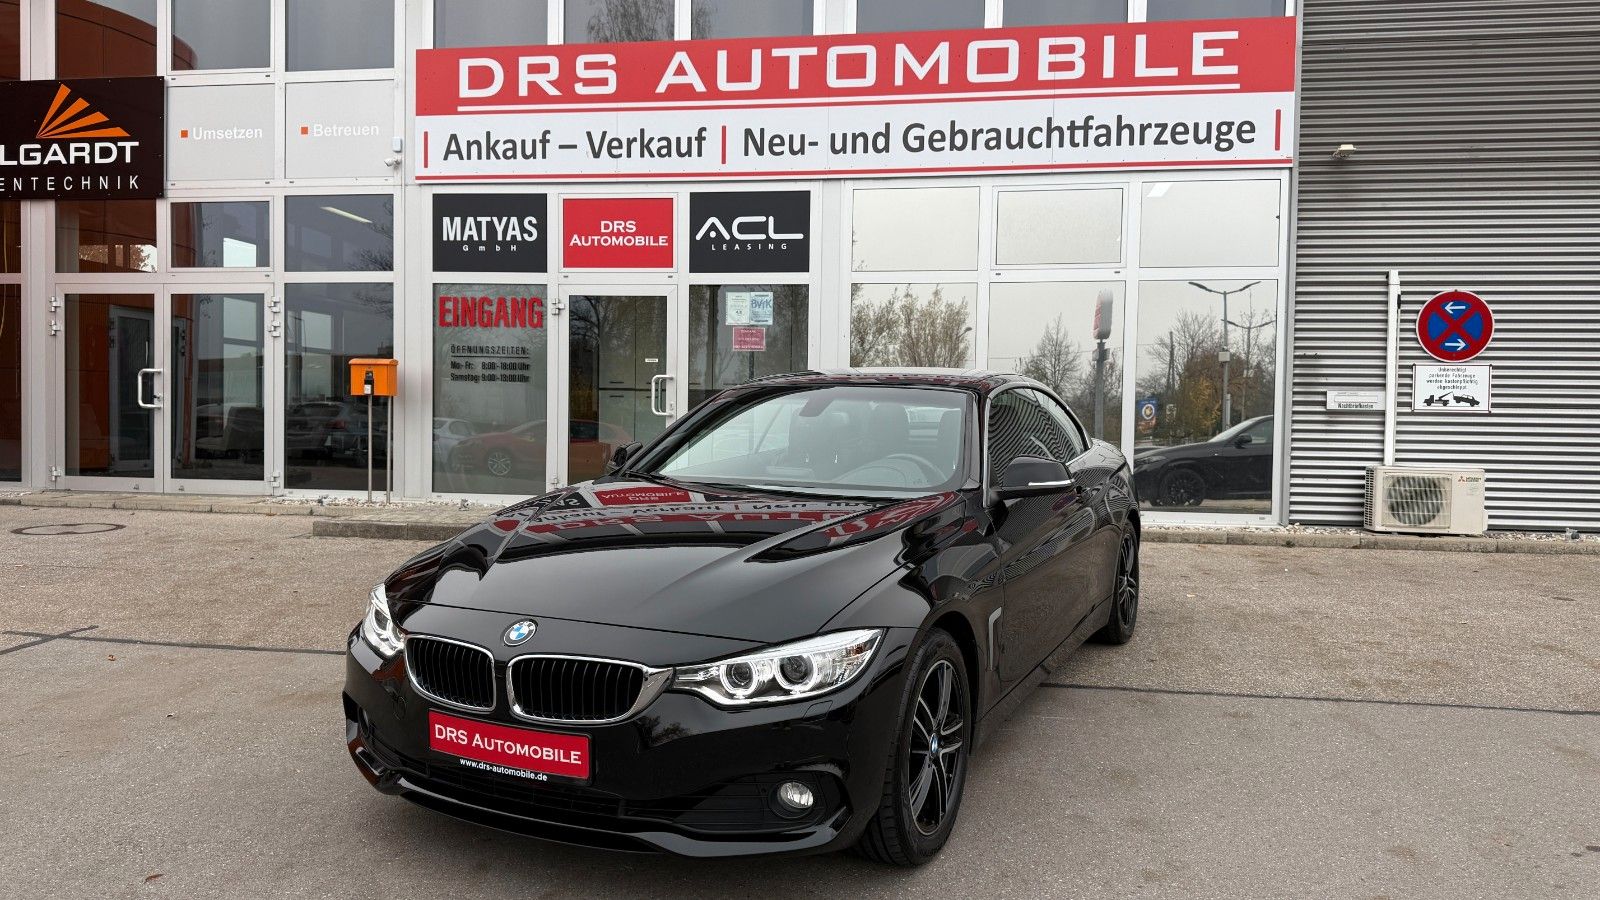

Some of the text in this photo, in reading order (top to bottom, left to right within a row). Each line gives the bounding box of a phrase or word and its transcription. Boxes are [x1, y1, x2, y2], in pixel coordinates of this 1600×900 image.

[458, 31, 1239, 98] DRS AUTOMOBILE
[192, 127, 263, 140] Umsetzen
[313, 124, 380, 137] Betreuen
[744, 115, 1256, 156] Neu- und Gebrauchtfahrzeuge
[0, 141, 140, 165] LGARDT
[443, 130, 551, 161] Ankauf
[586, 127, 707, 159] Verkauf
[442, 216, 538, 242] MATYAS
[600, 220, 637, 233] DRS
[695, 215, 804, 241] ACL
[569, 234, 669, 247] AUTOMOBILE
[711, 243, 787, 251] LEASING
[438, 295, 544, 328] EINGANG
[435, 724, 581, 765] DRS AUTOMOBILE
[459, 758, 548, 781] www.drs-automobile.de
